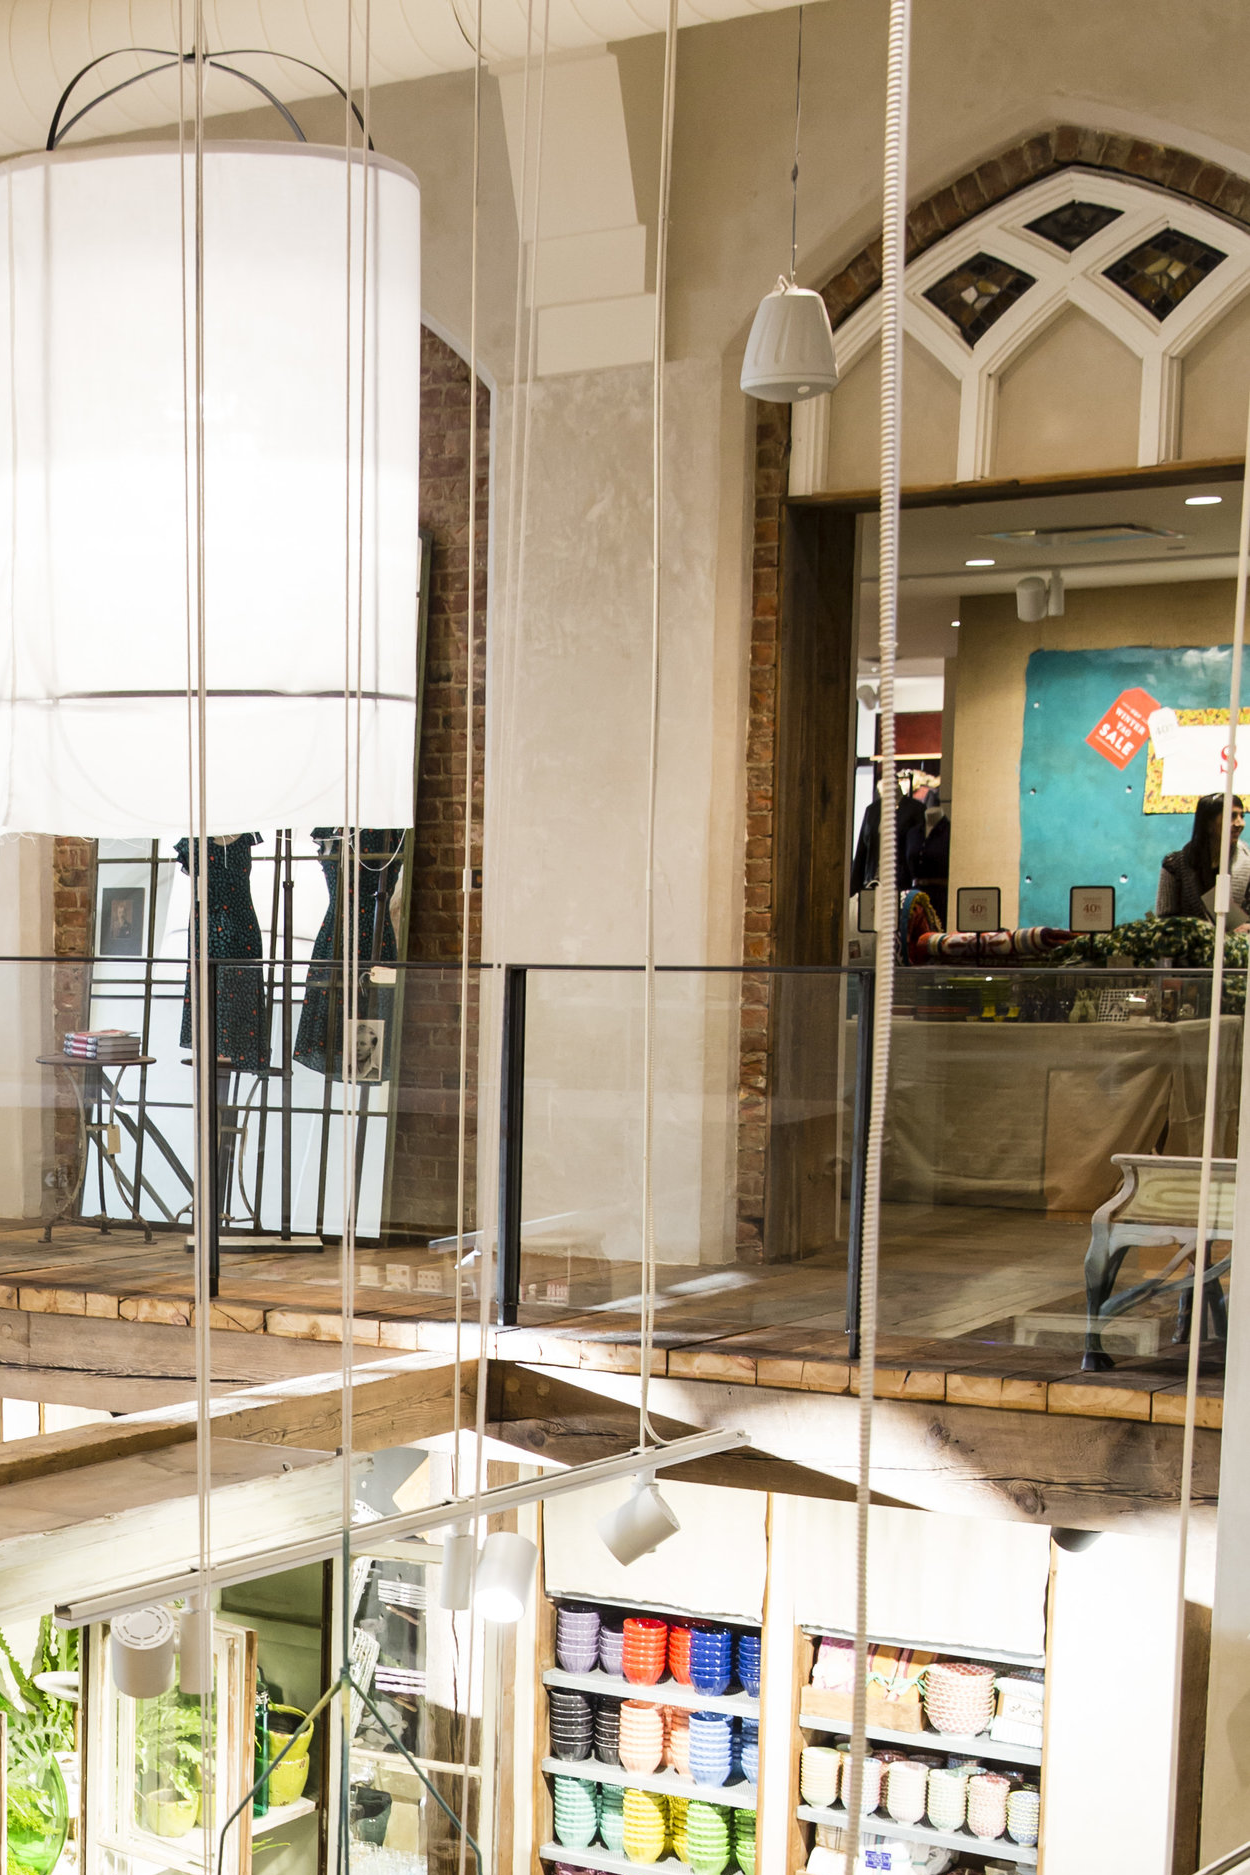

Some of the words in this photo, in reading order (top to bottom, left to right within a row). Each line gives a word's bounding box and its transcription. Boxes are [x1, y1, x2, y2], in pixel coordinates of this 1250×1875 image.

[1115, 706, 1146, 737] WINTER
[1116, 721, 1132, 738] TAG
[1098, 723, 1135, 757] SALE
